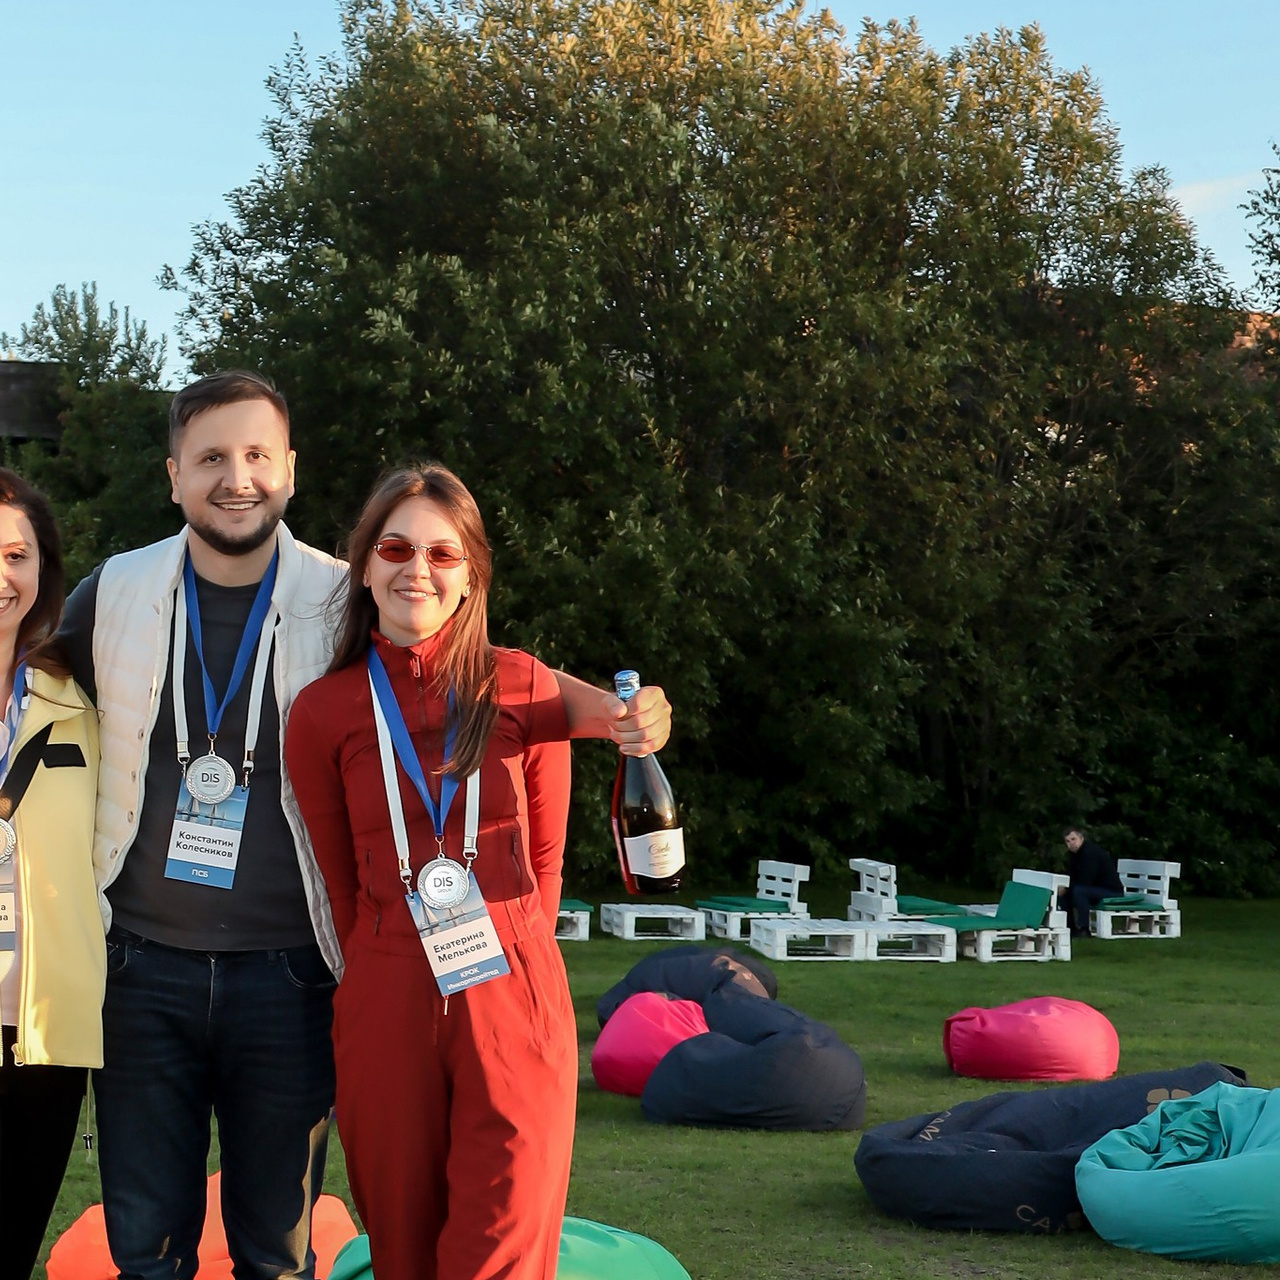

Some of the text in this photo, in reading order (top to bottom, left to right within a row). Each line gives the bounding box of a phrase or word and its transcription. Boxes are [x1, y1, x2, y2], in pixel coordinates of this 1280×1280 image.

[201, 772, 220, 783] DIS
[178, 830, 234, 848] Константин
[175, 841, 233, 858] Колесников
[191, 868, 209, 878] ПСБ
[433, 876, 454, 888] DIS
[433, 930, 485, 954] Екатерина
[437, 940, 488, 963] Мелькова
